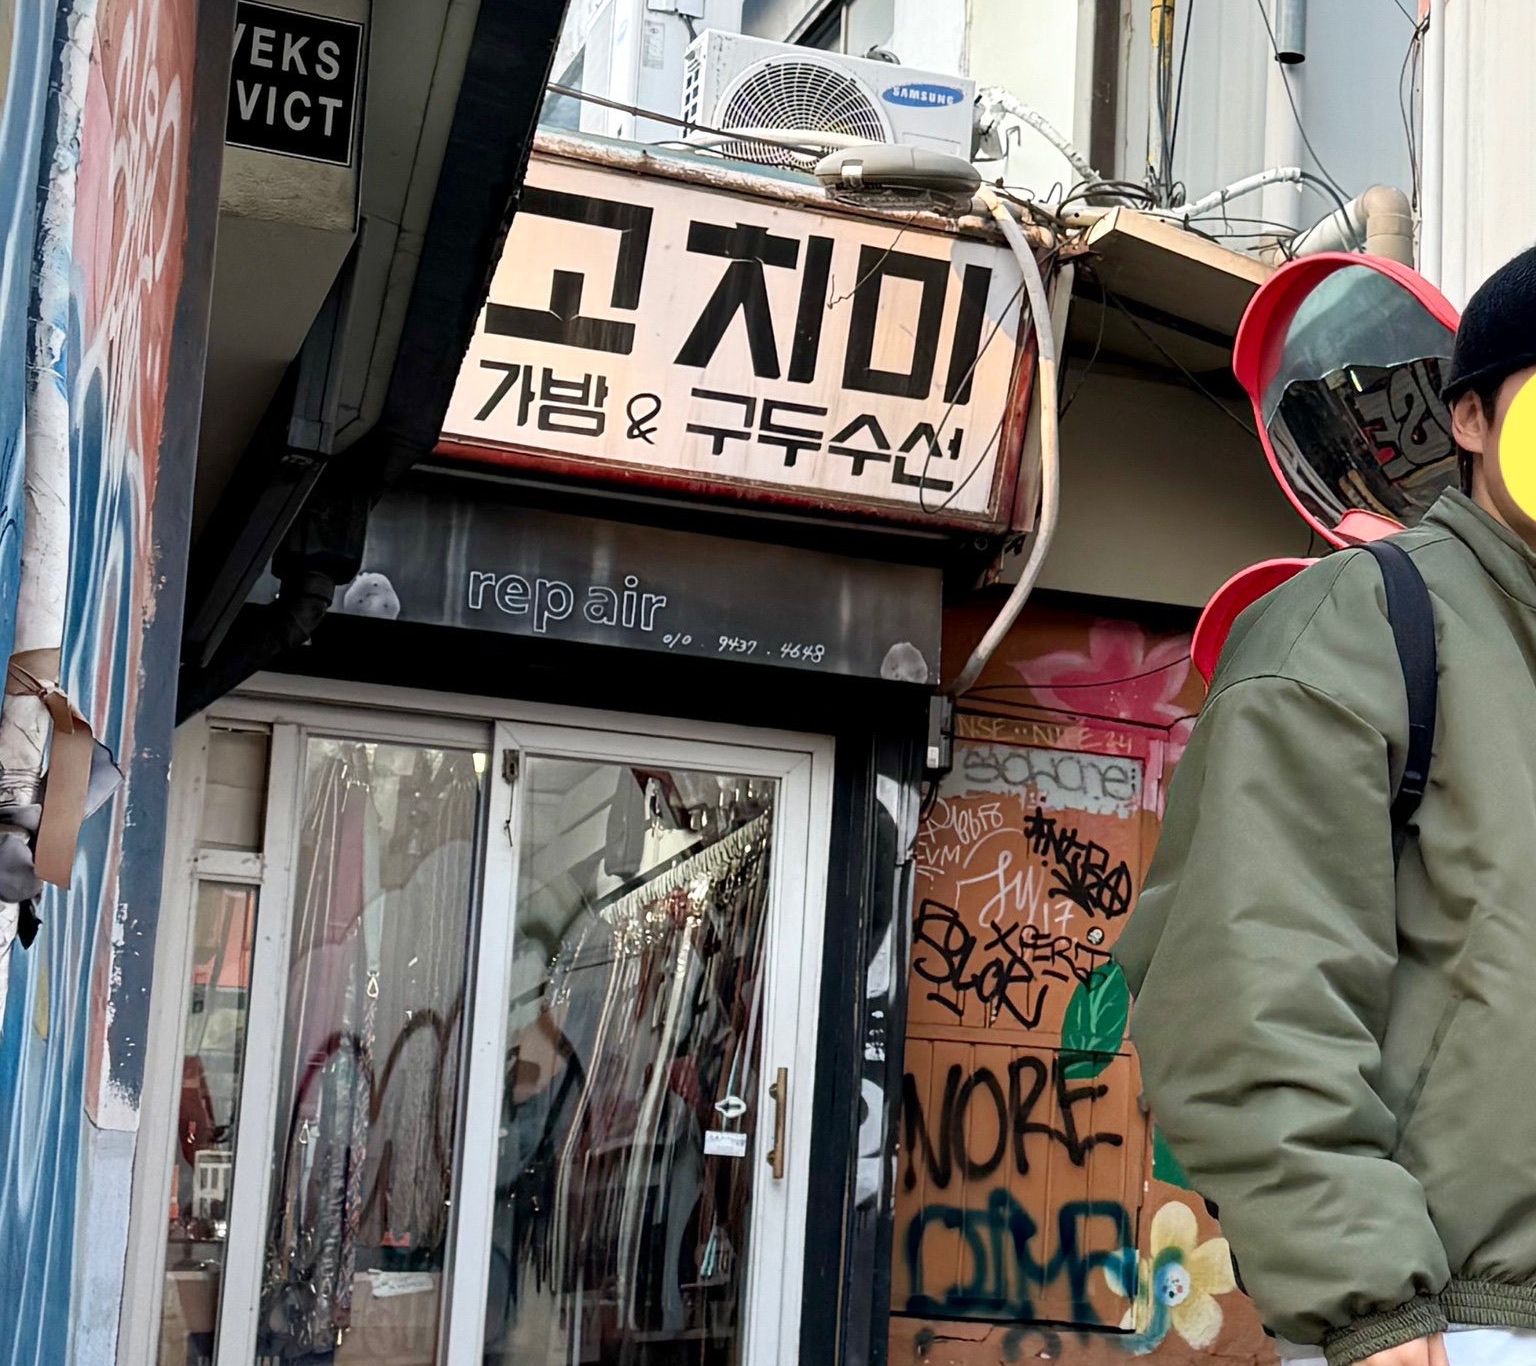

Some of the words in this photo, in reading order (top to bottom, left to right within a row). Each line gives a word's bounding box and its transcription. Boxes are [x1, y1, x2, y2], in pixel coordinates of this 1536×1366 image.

[892, 86, 955, 106] SAMSUNG
[626, 392, 662, 445] &
[685, 387, 961, 493] 구두수선
[468, 570, 667, 633] repair
